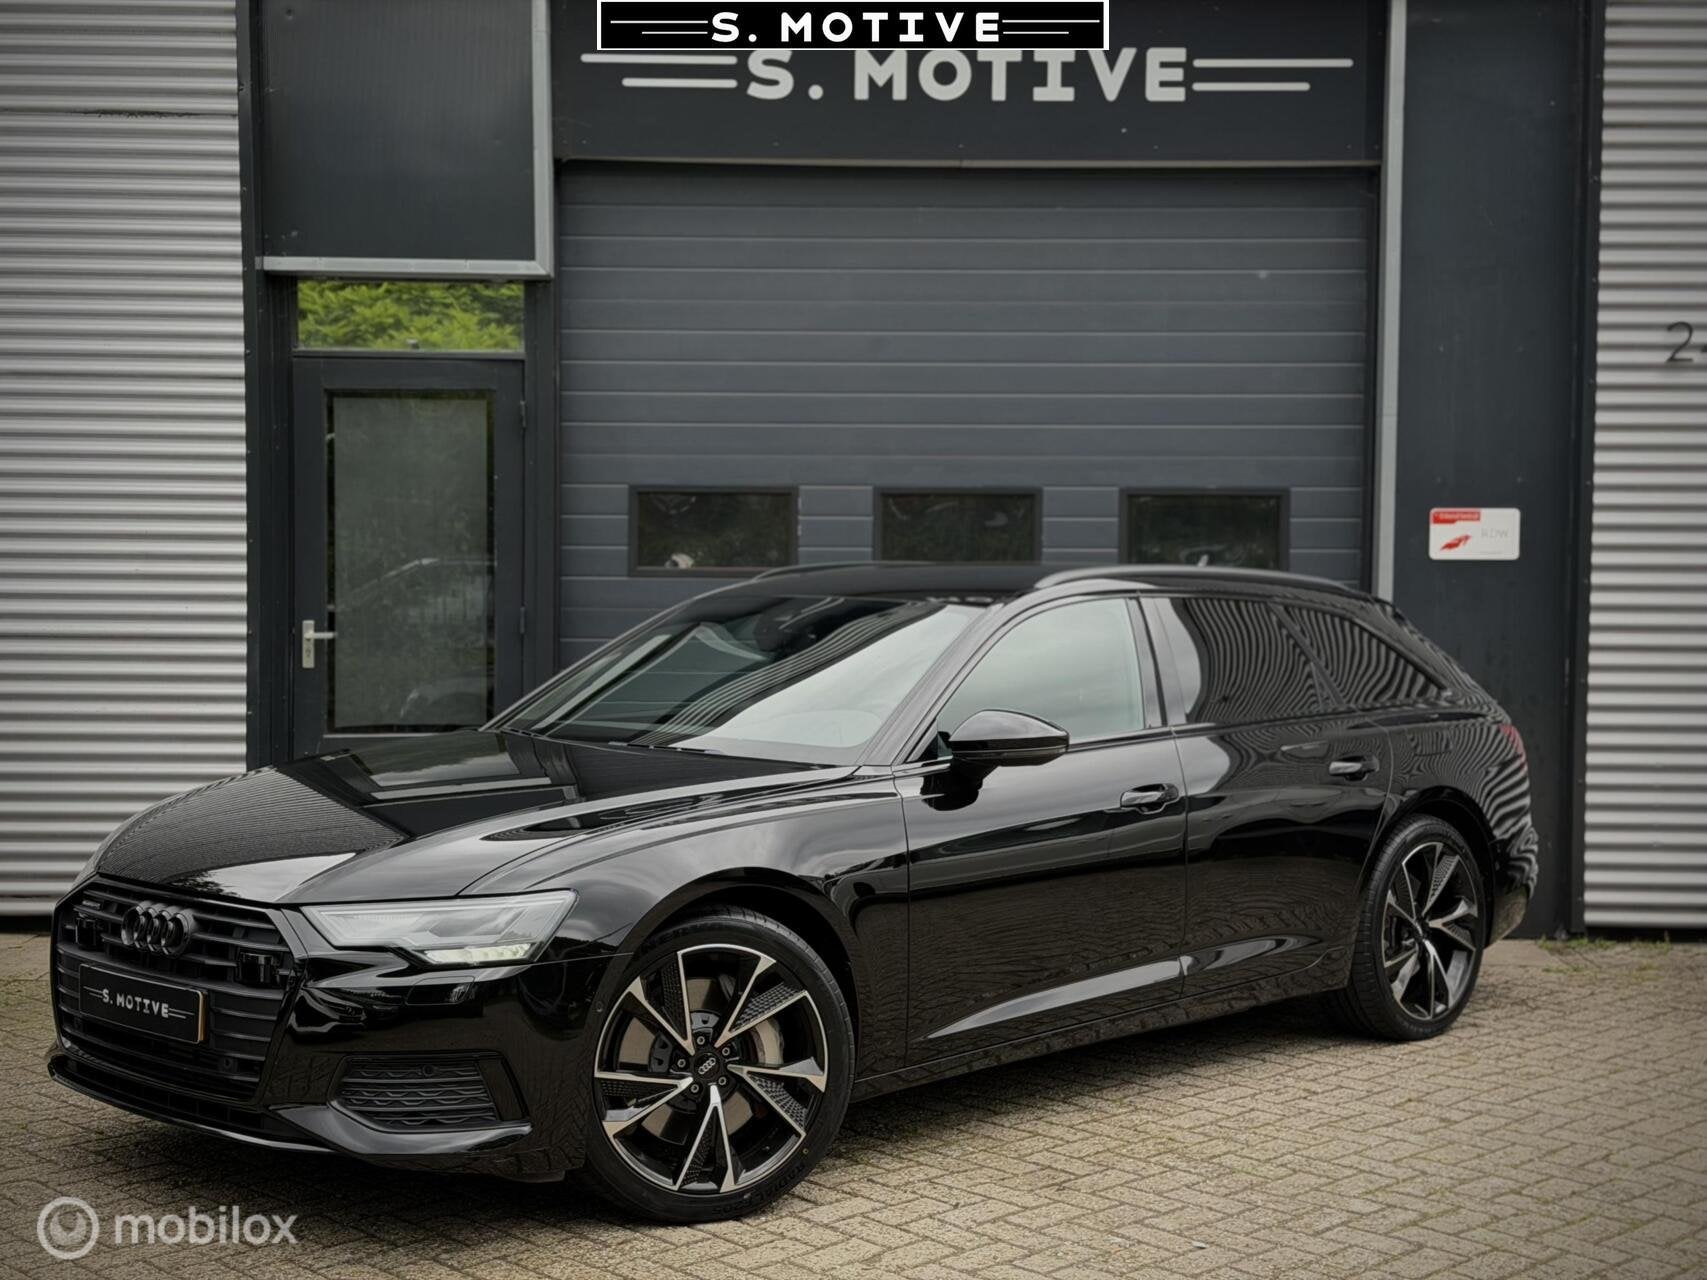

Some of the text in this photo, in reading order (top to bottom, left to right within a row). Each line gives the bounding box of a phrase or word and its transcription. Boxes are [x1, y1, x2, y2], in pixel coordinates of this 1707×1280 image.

[746, 48, 1187, 102] S. MOTIVE
[102, 988, 169, 1018] S. MOTIVE
